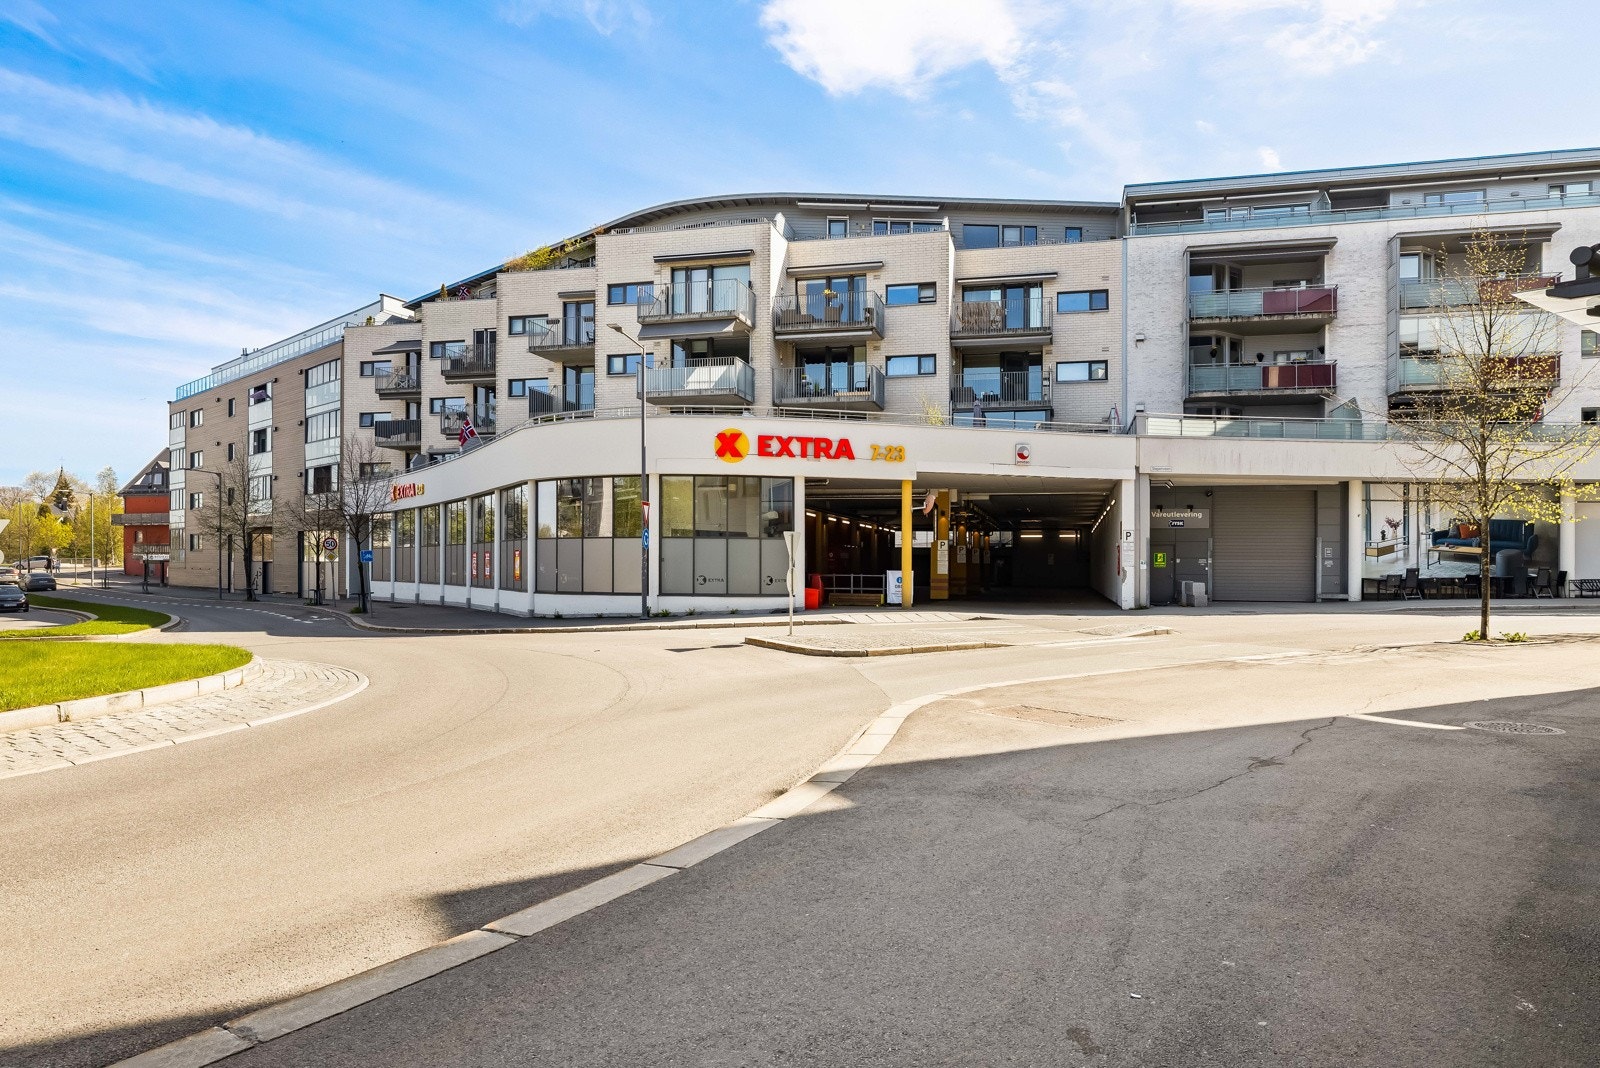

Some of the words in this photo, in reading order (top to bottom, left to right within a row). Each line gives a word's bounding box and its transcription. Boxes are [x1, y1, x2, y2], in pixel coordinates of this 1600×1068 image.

[757, 435, 855, 460] EXTRA
[870, 444, 905, 462] 7-23
[397, 483, 416, 500] EXTRA
[1151, 511, 1203, 519] Vareutlevering
[1125, 531, 1132, 541] P
[325, 540, 336, 548] 50
[940, 541, 946, 549] P
